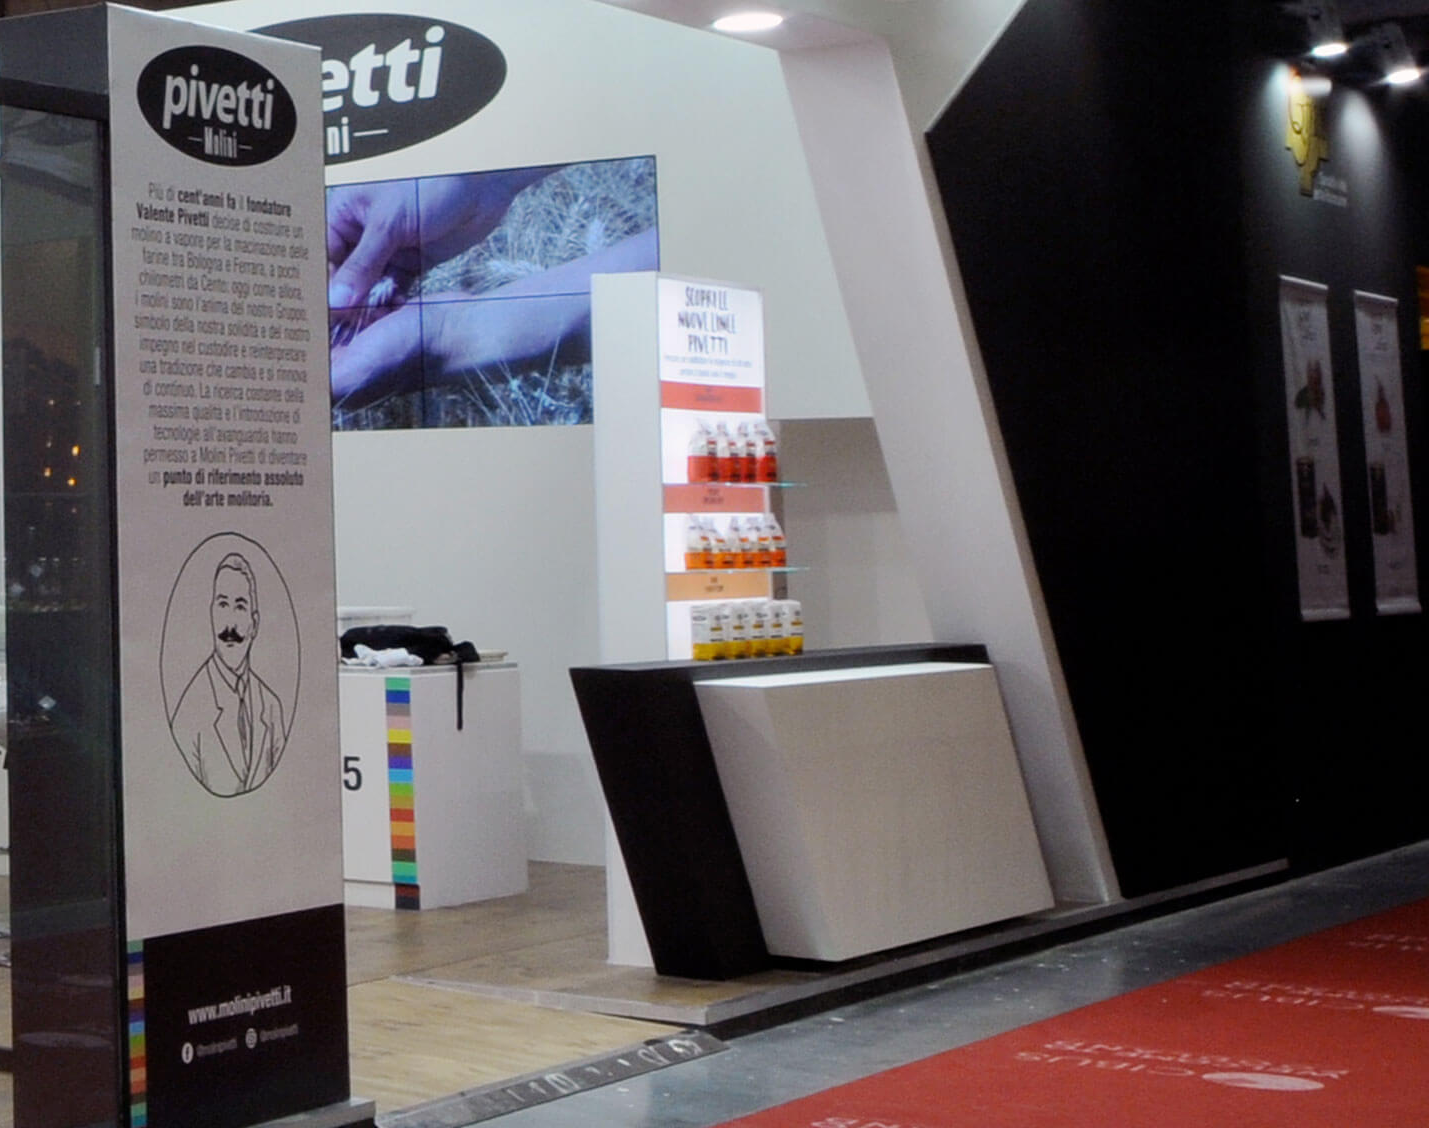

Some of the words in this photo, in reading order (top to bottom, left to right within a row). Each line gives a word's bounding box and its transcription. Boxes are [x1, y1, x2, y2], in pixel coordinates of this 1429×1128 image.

[321, 26, 445, 112] etti
[162, 64, 275, 130] pivetti
[203, 126, 238, 158] Molini
[326, 116, 350, 156] ni
[177, 189, 224, 208] cent'anni
[226, 192, 236, 210] fa
[246, 195, 292, 217] fondatore
[136, 202, 175, 223] Valente
[178, 207, 209, 228] Pivetti
[173, 232, 204, 250] vapore
[187, 251, 223, 274] Bologna
[253, 282, 275, 298] come
[677, 312, 708, 332] NUOVE
[710, 312, 738, 334] LINEE
[686, 334, 729, 354] PIVETTI
[159, 358, 204, 376] tradizione
[143, 447, 189, 465] permesso
[199, 446, 226, 463] Molini
[163, 468, 192, 488] punto
[195, 467, 204, 485] di
[207, 467, 261, 485] riferimento
[264, 470, 304, 486] assoluto
[183, 489, 225, 506] dell'arte
[227, 490, 273, 507] molitoria.
[343, 756, 362, 791] 5
[187, 984, 293, 1026] www.molinipivetti.it
